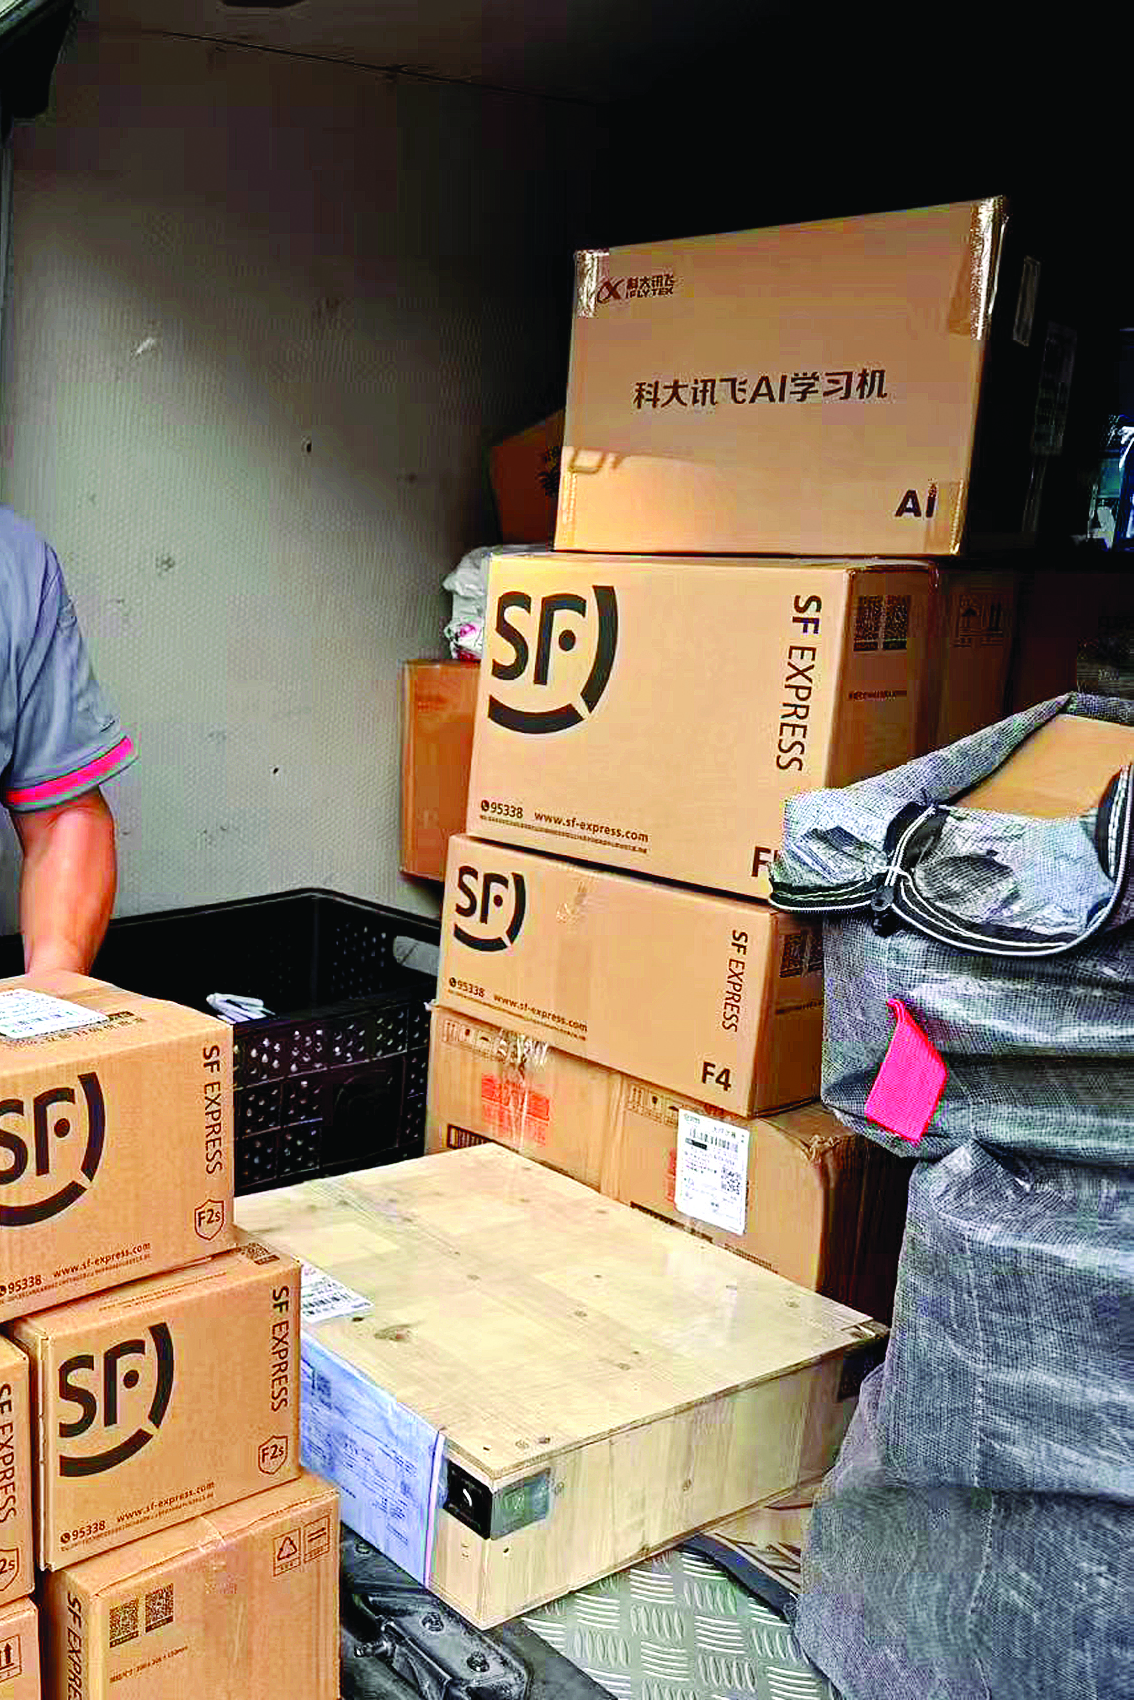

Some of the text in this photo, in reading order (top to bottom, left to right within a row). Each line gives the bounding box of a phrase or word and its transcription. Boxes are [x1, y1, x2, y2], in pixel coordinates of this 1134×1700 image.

[634, 368, 887, 408] 科大讯飞AI学习机
[776, 595, 821, 771] SF EXPRESS
[491, 801, 523, 819] 95338
[534, 811, 649, 843] www.sf-express.com
[751, 846, 778, 877] F
[721, 930, 748, 1033] SF EXPRESS
[494, 993, 588, 1032] www.sf-express.com
[702, 1062, 731, 1091] F4
[203, 1045, 222, 1174] SF EXPRESS
[198, 1209, 221, 1227] F2s
[8, 1274, 42, 1294] 95338
[54, 1242, 151, 1278] www.sf-express.com
[272, 1285, 289, 1411] SF EXPRESS
[262, 1444, 284, 1463] F2s
[72, 1520, 106, 1541] 95338
[117, 1481, 215, 1523] www.sf-express.com
[67, 1592, 83, 1700] SF EXPRE
